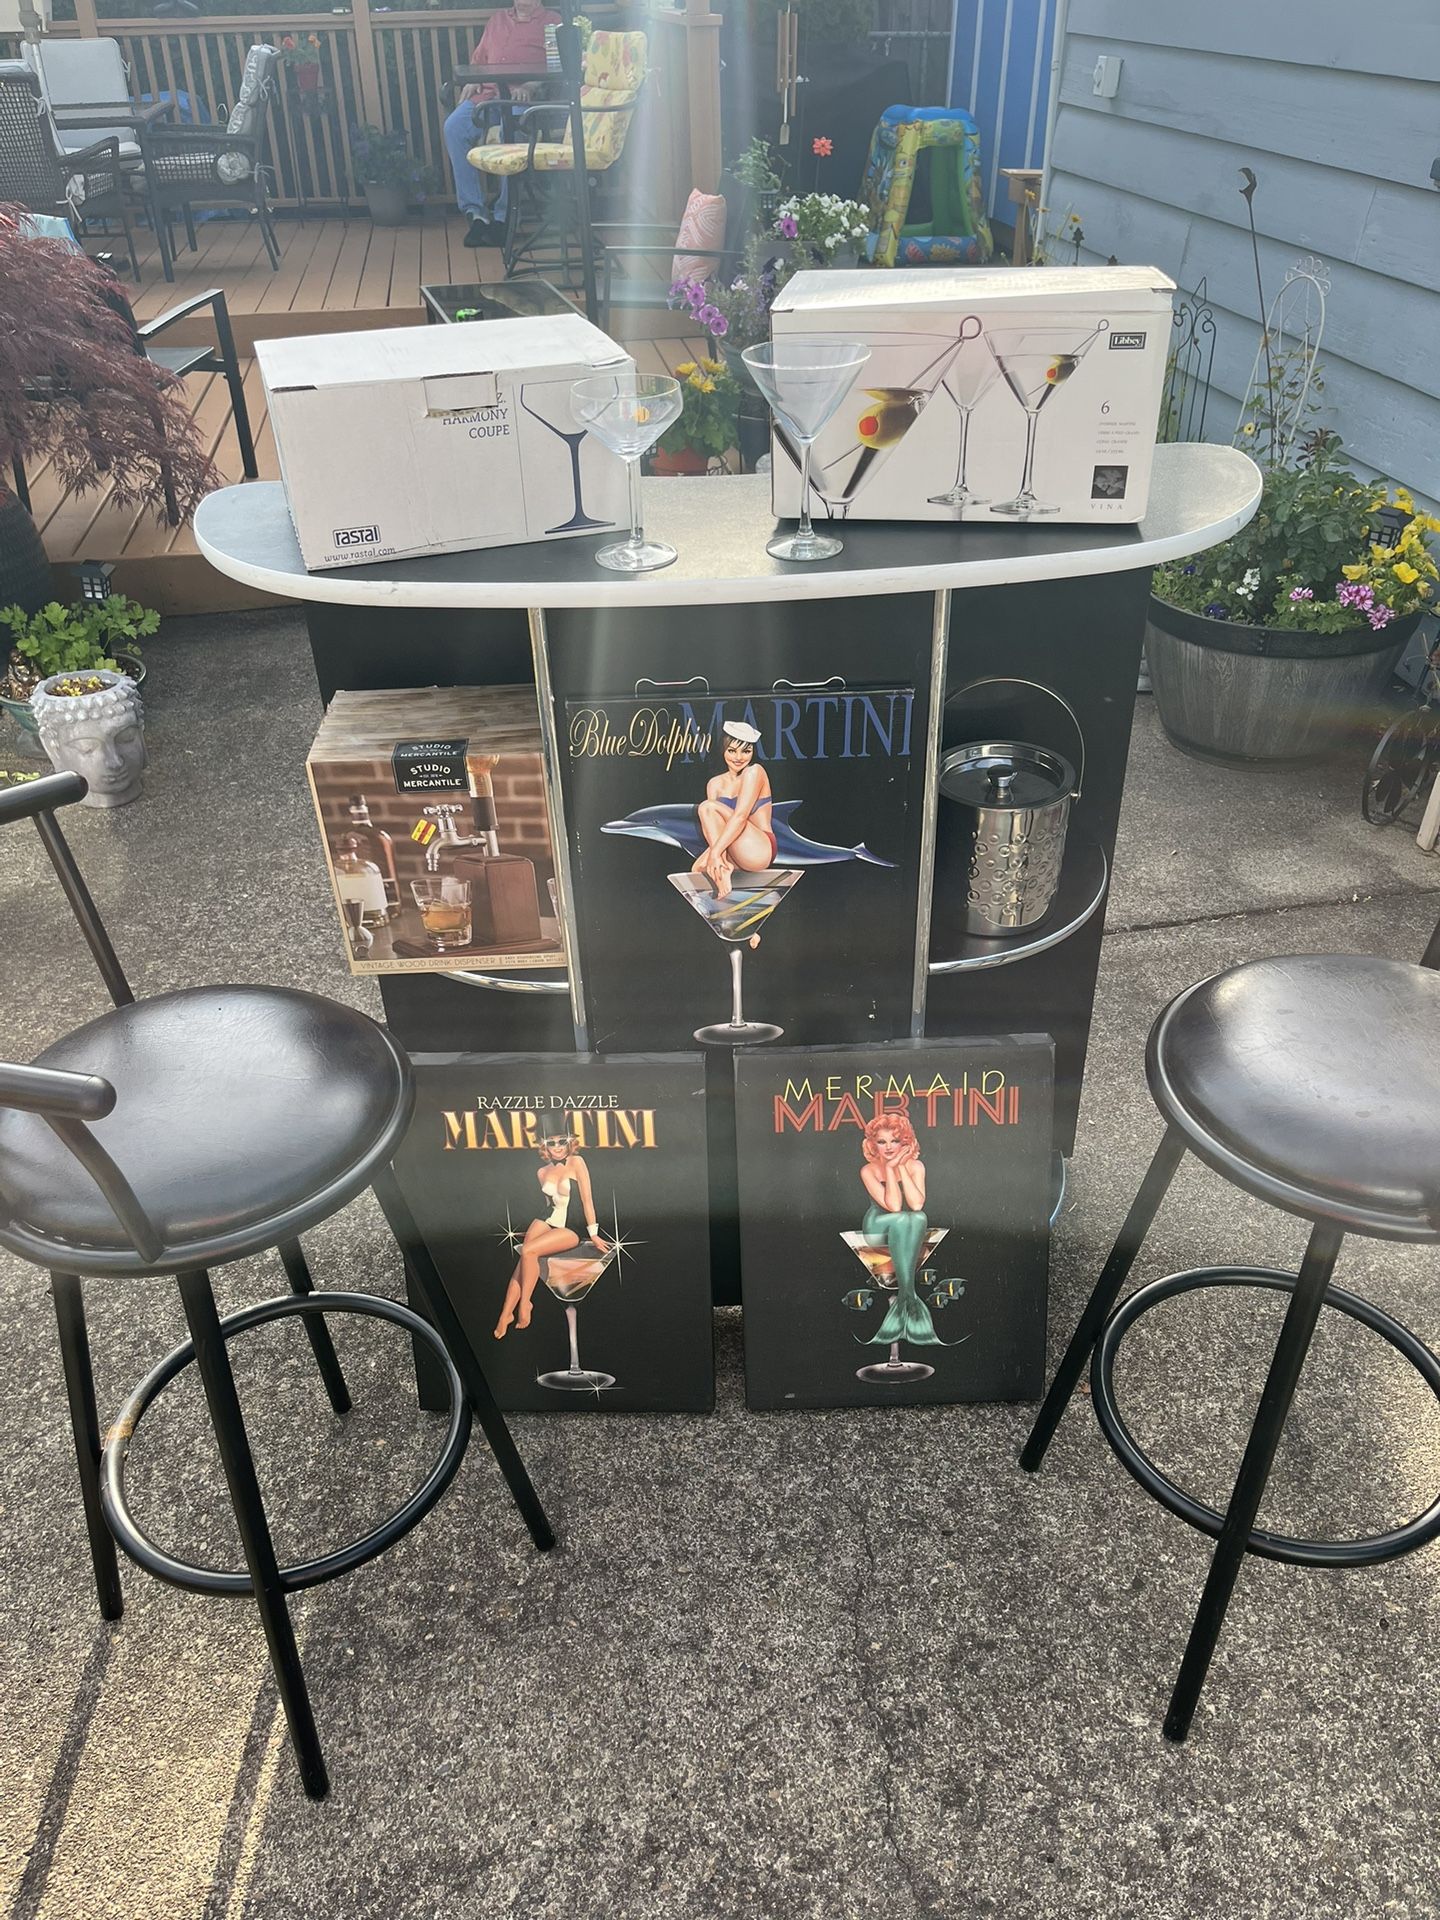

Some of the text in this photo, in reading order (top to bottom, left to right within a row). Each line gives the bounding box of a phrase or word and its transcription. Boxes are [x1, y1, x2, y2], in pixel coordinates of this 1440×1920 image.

[1114, 336, 1141, 346] Libbey
[1101, 400, 1110, 415] 6
[469, 424, 510, 439] COUPE
[335, 526, 379, 546] rastal
[324, 547, 396, 562] www.rastal.com
[569, 694, 913, 772] Blue Dolphin MARTINI
[400, 750, 459, 758] MERCANTILE
[411, 743, 452, 751] STUDIO
[410, 763, 451, 775] STUDIO
[403, 778, 462, 788] MERCANTILE
[399, 960, 426, 968] WOOD
[428, 959, 450, 967] DRINK
[454, 957, 495, 966] DISPENSER
[783, 1070, 1006, 1102] MERMAID
[477, 1095, 619, 1110] RAZZLE DAZZLE
[773, 1086, 1020, 1134] MARTINI
[440, 1108, 659, 1150] MARTINI
